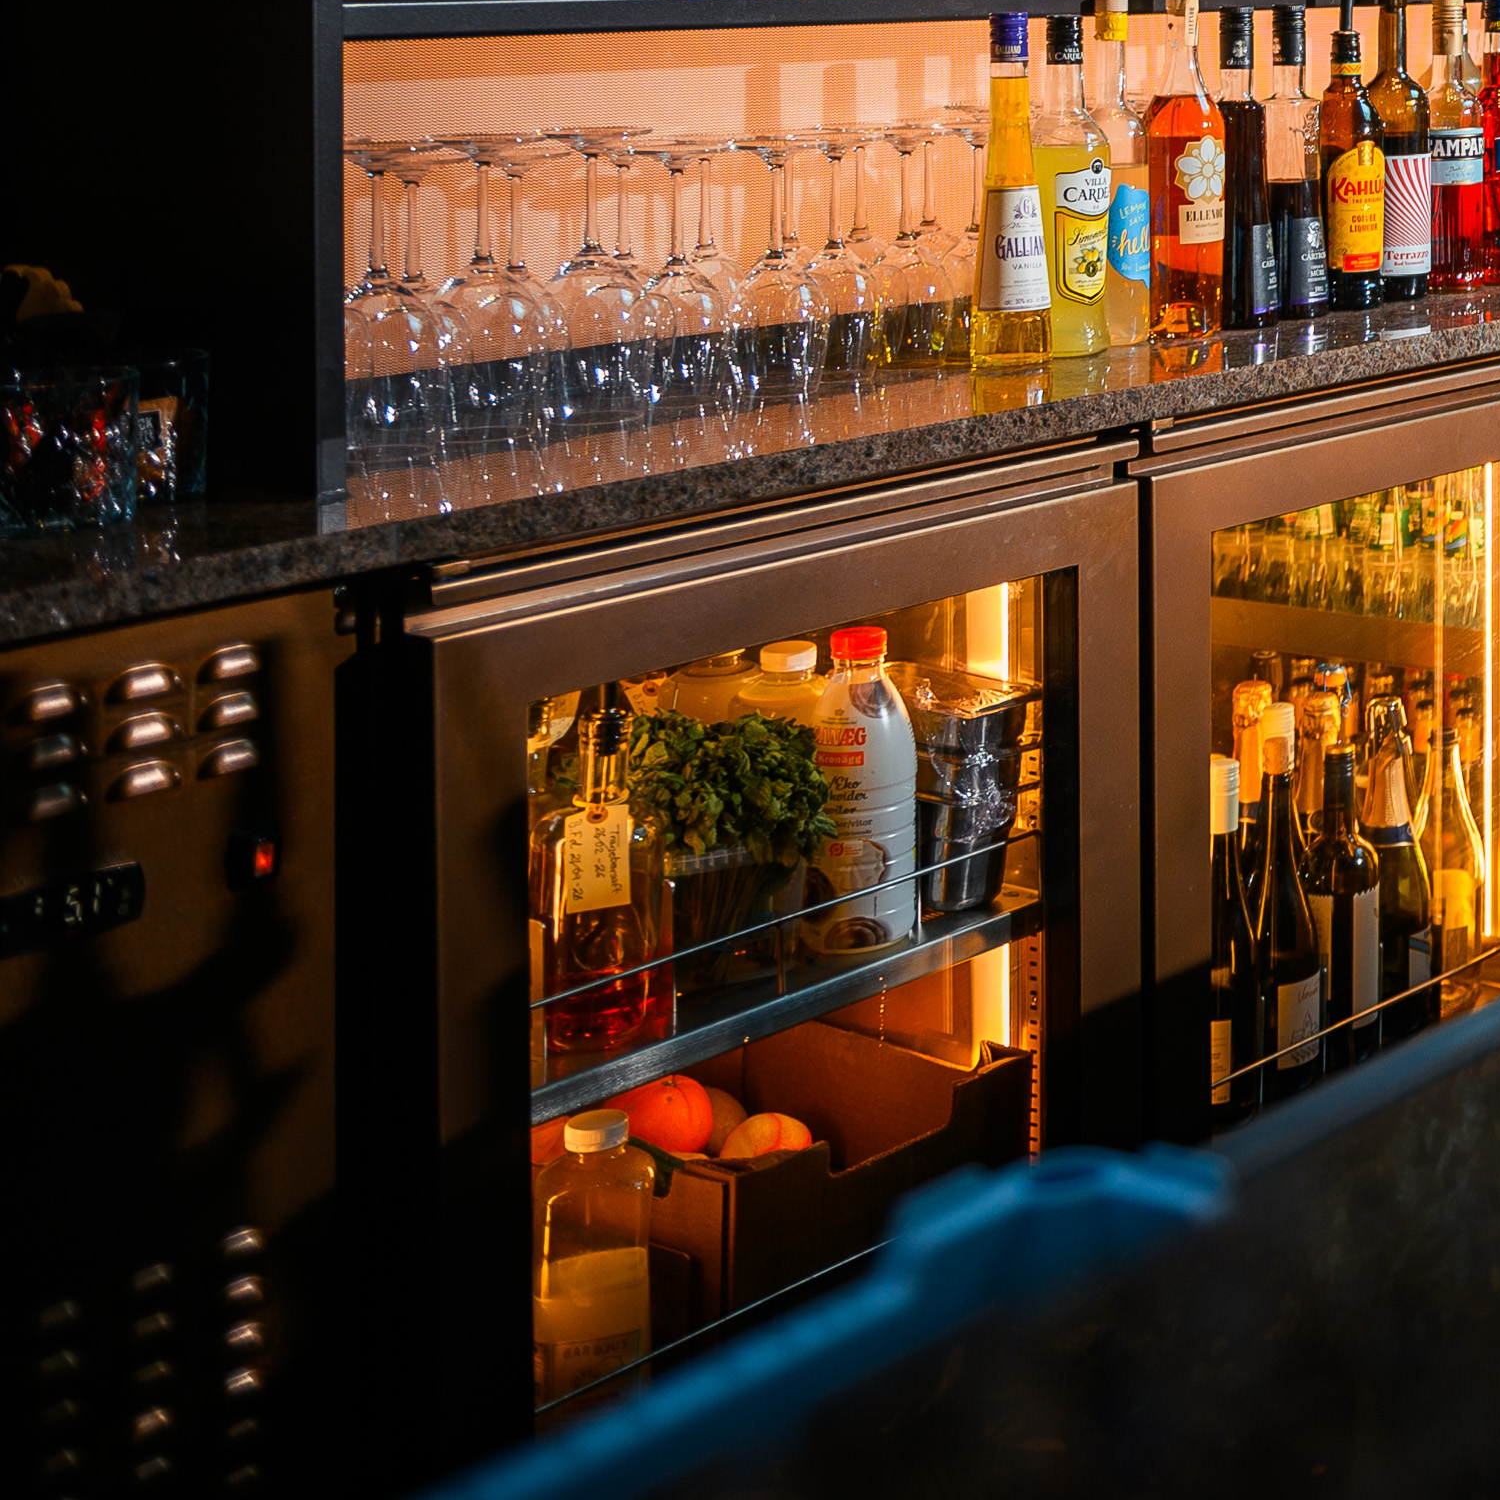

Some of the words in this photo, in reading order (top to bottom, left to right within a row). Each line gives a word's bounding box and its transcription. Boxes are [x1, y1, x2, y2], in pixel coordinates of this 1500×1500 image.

[1085, 177, 1107, 186] VILLA
[1063, 187, 1110, 203] CARDE
[1351, 214, 1376, 223] COFFEE
[1012, 262, 1042, 270] VANILLA
[818, 753, 862, 766] Kronägg
